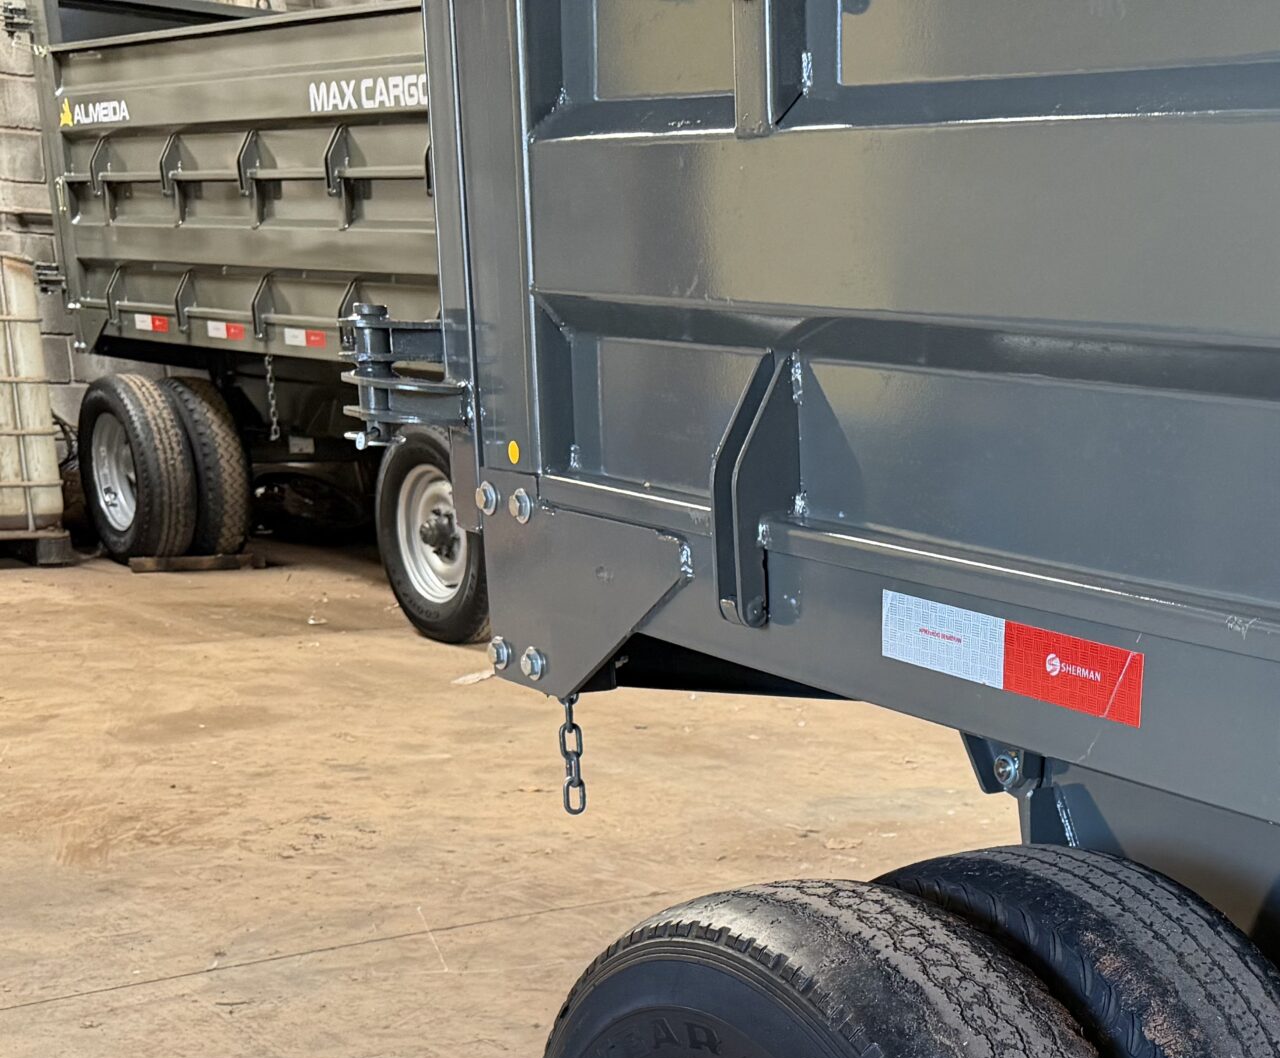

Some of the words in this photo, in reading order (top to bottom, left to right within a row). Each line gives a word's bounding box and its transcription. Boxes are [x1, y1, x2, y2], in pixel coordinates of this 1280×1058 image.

[308, 79, 358, 112] MAX
[360, 73, 428, 109] CARGO
[1060, 662, 1102, 682] SHERMAN
